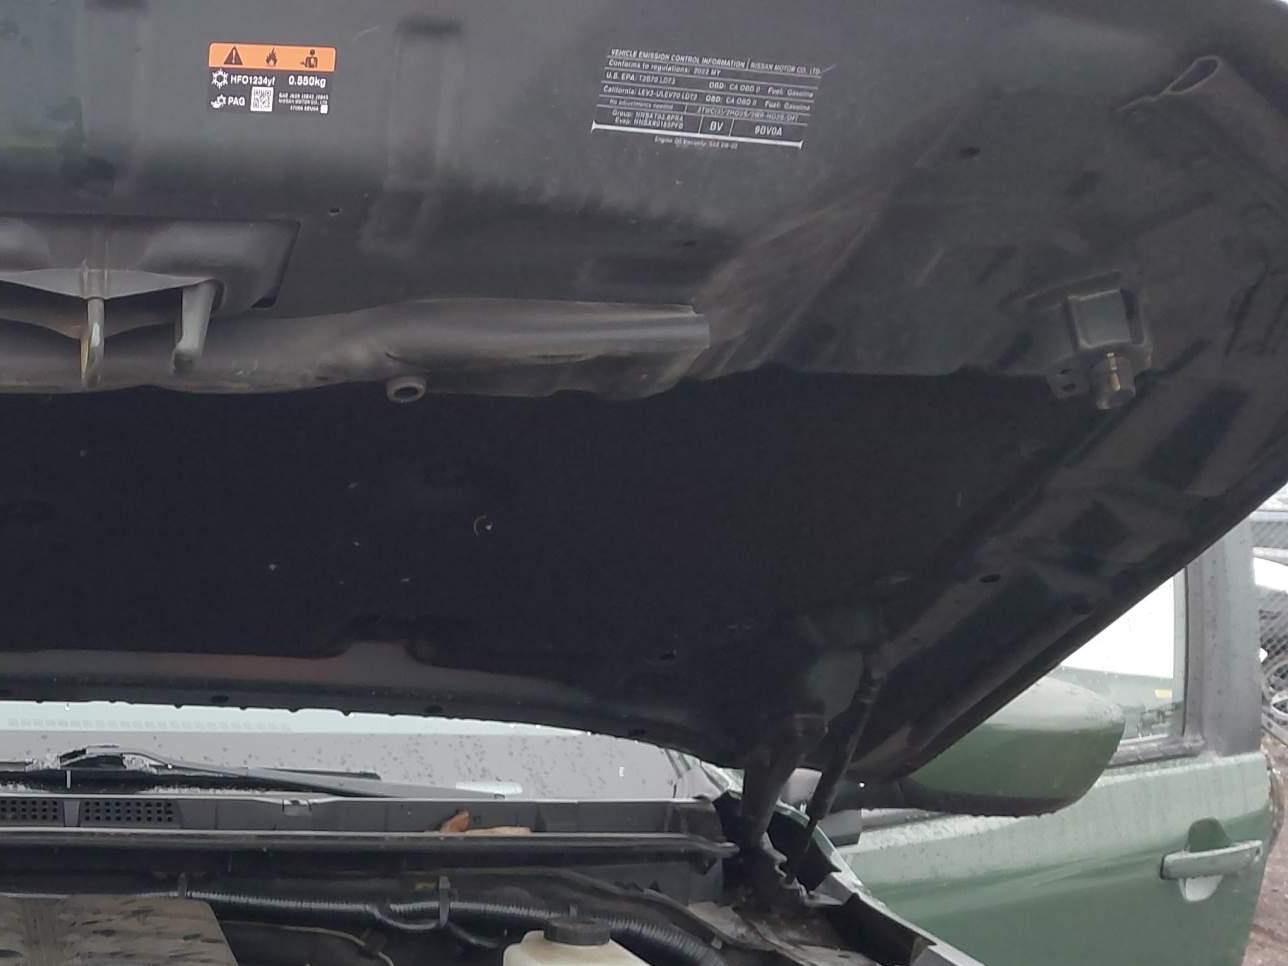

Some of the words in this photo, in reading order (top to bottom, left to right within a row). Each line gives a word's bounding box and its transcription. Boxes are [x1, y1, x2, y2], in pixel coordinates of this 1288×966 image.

[608, 59, 640, 68] Conforms
[611, 49, 637, 58] VEHICLE
[639, 50, 669, 60] EMISSION
[671, 54, 700, 63] CONTROL
[701, 57, 745, 68] INFORMATION
[230, 75, 275, 86] HFO1234yf
[729, 83, 738, 91] CA
[740, 84, 754, 92] OBD
[228, 96, 246, 106] PAG
